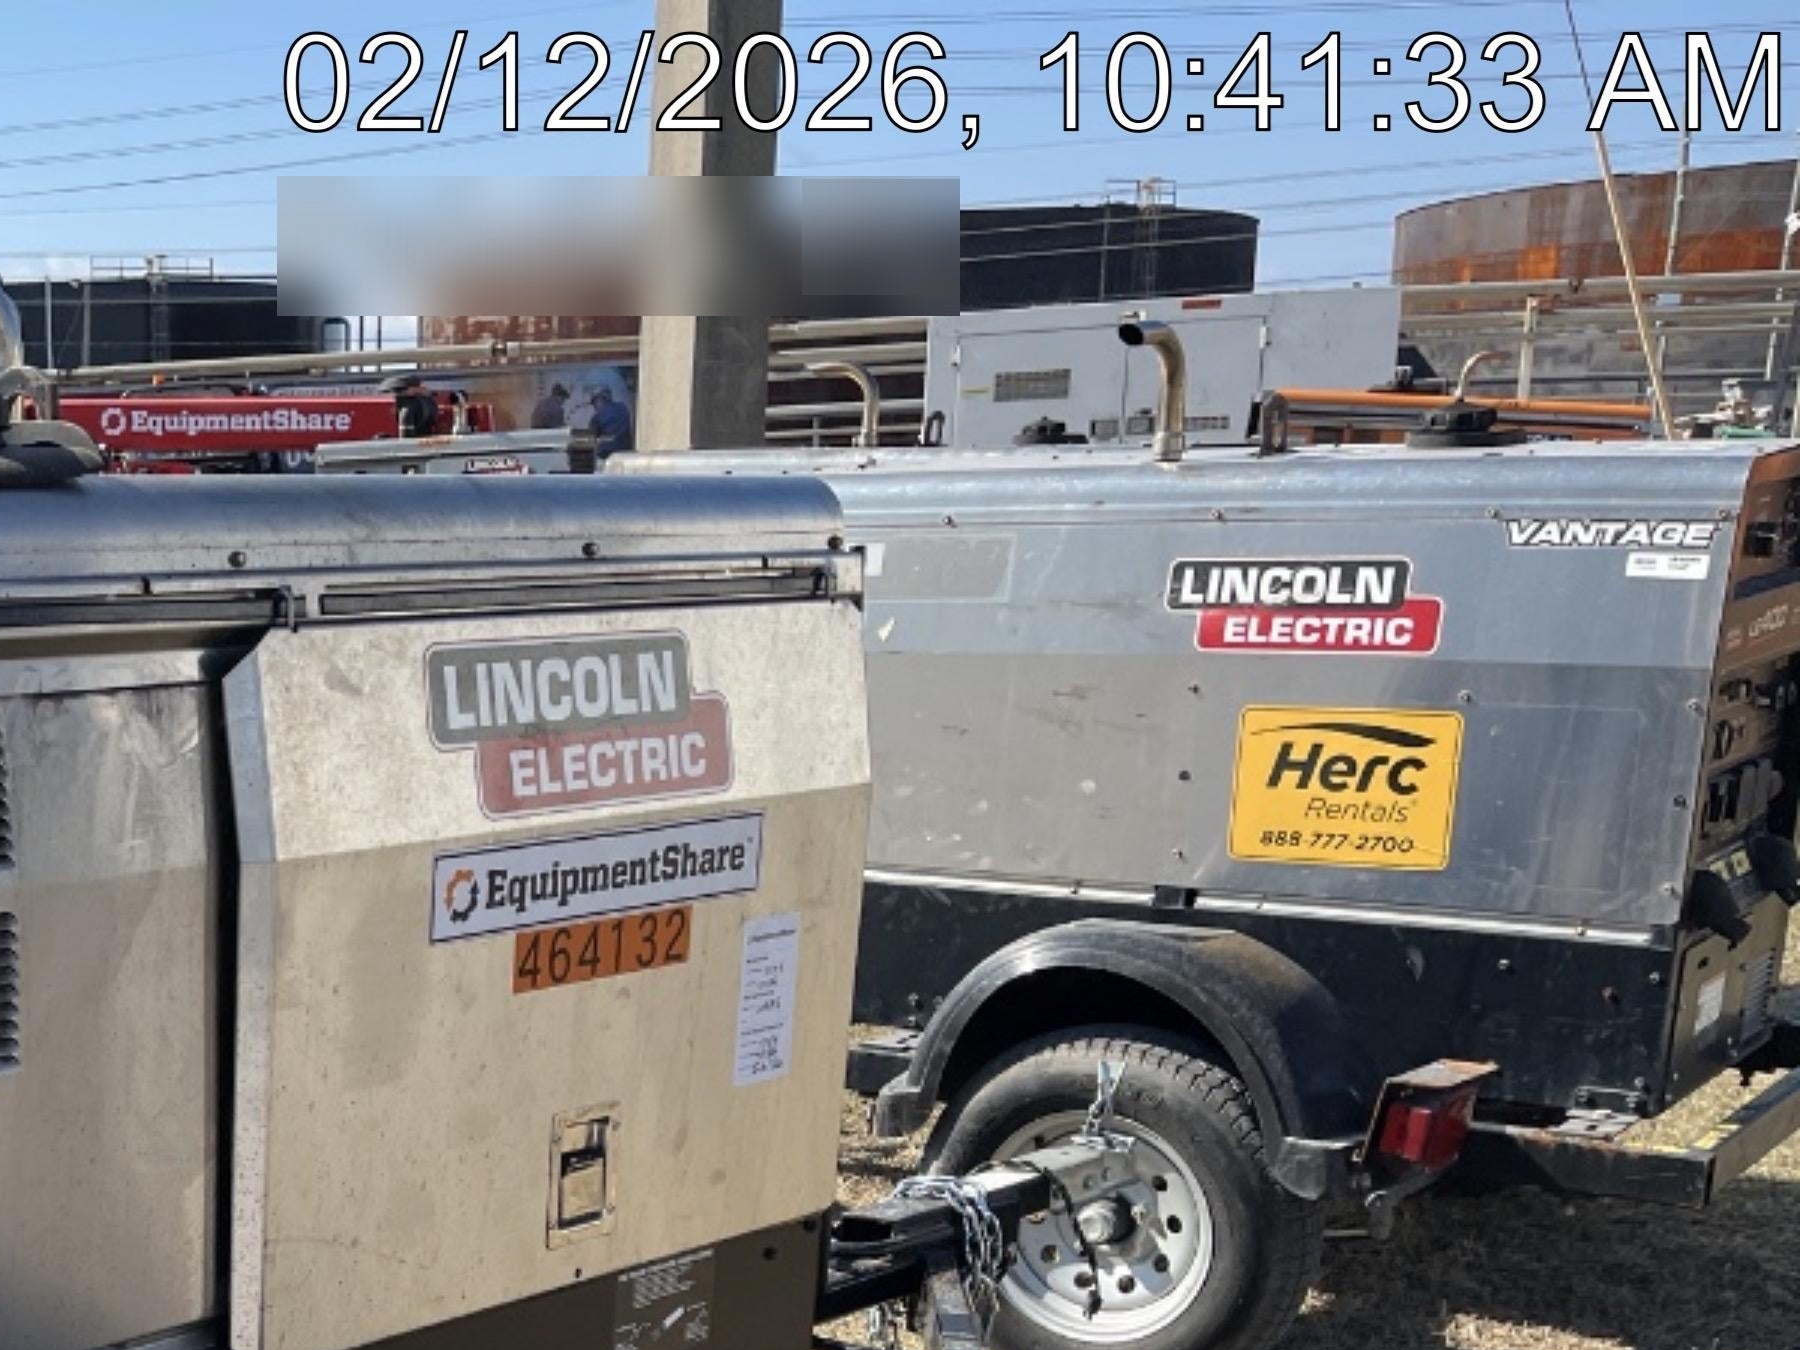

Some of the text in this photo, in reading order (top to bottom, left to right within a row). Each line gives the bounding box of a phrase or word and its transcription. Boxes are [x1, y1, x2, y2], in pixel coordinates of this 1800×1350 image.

[131, 409, 352, 435] EquipmentShare
[1506, 519, 1717, 547] VANTAGE
[1178, 565, 1397, 605] LINCOLN
[1223, 616, 1415, 646] ELECTRIC
[443, 649, 678, 731] LINCOLN
[508, 731, 707, 799] ELECTRIC
[1265, 741, 1428, 796] Herc
[1304, 797, 1409, 824] Rentals
[485, 840, 746, 914] EquipmentShare
[518, 908, 687, 987] 464132
